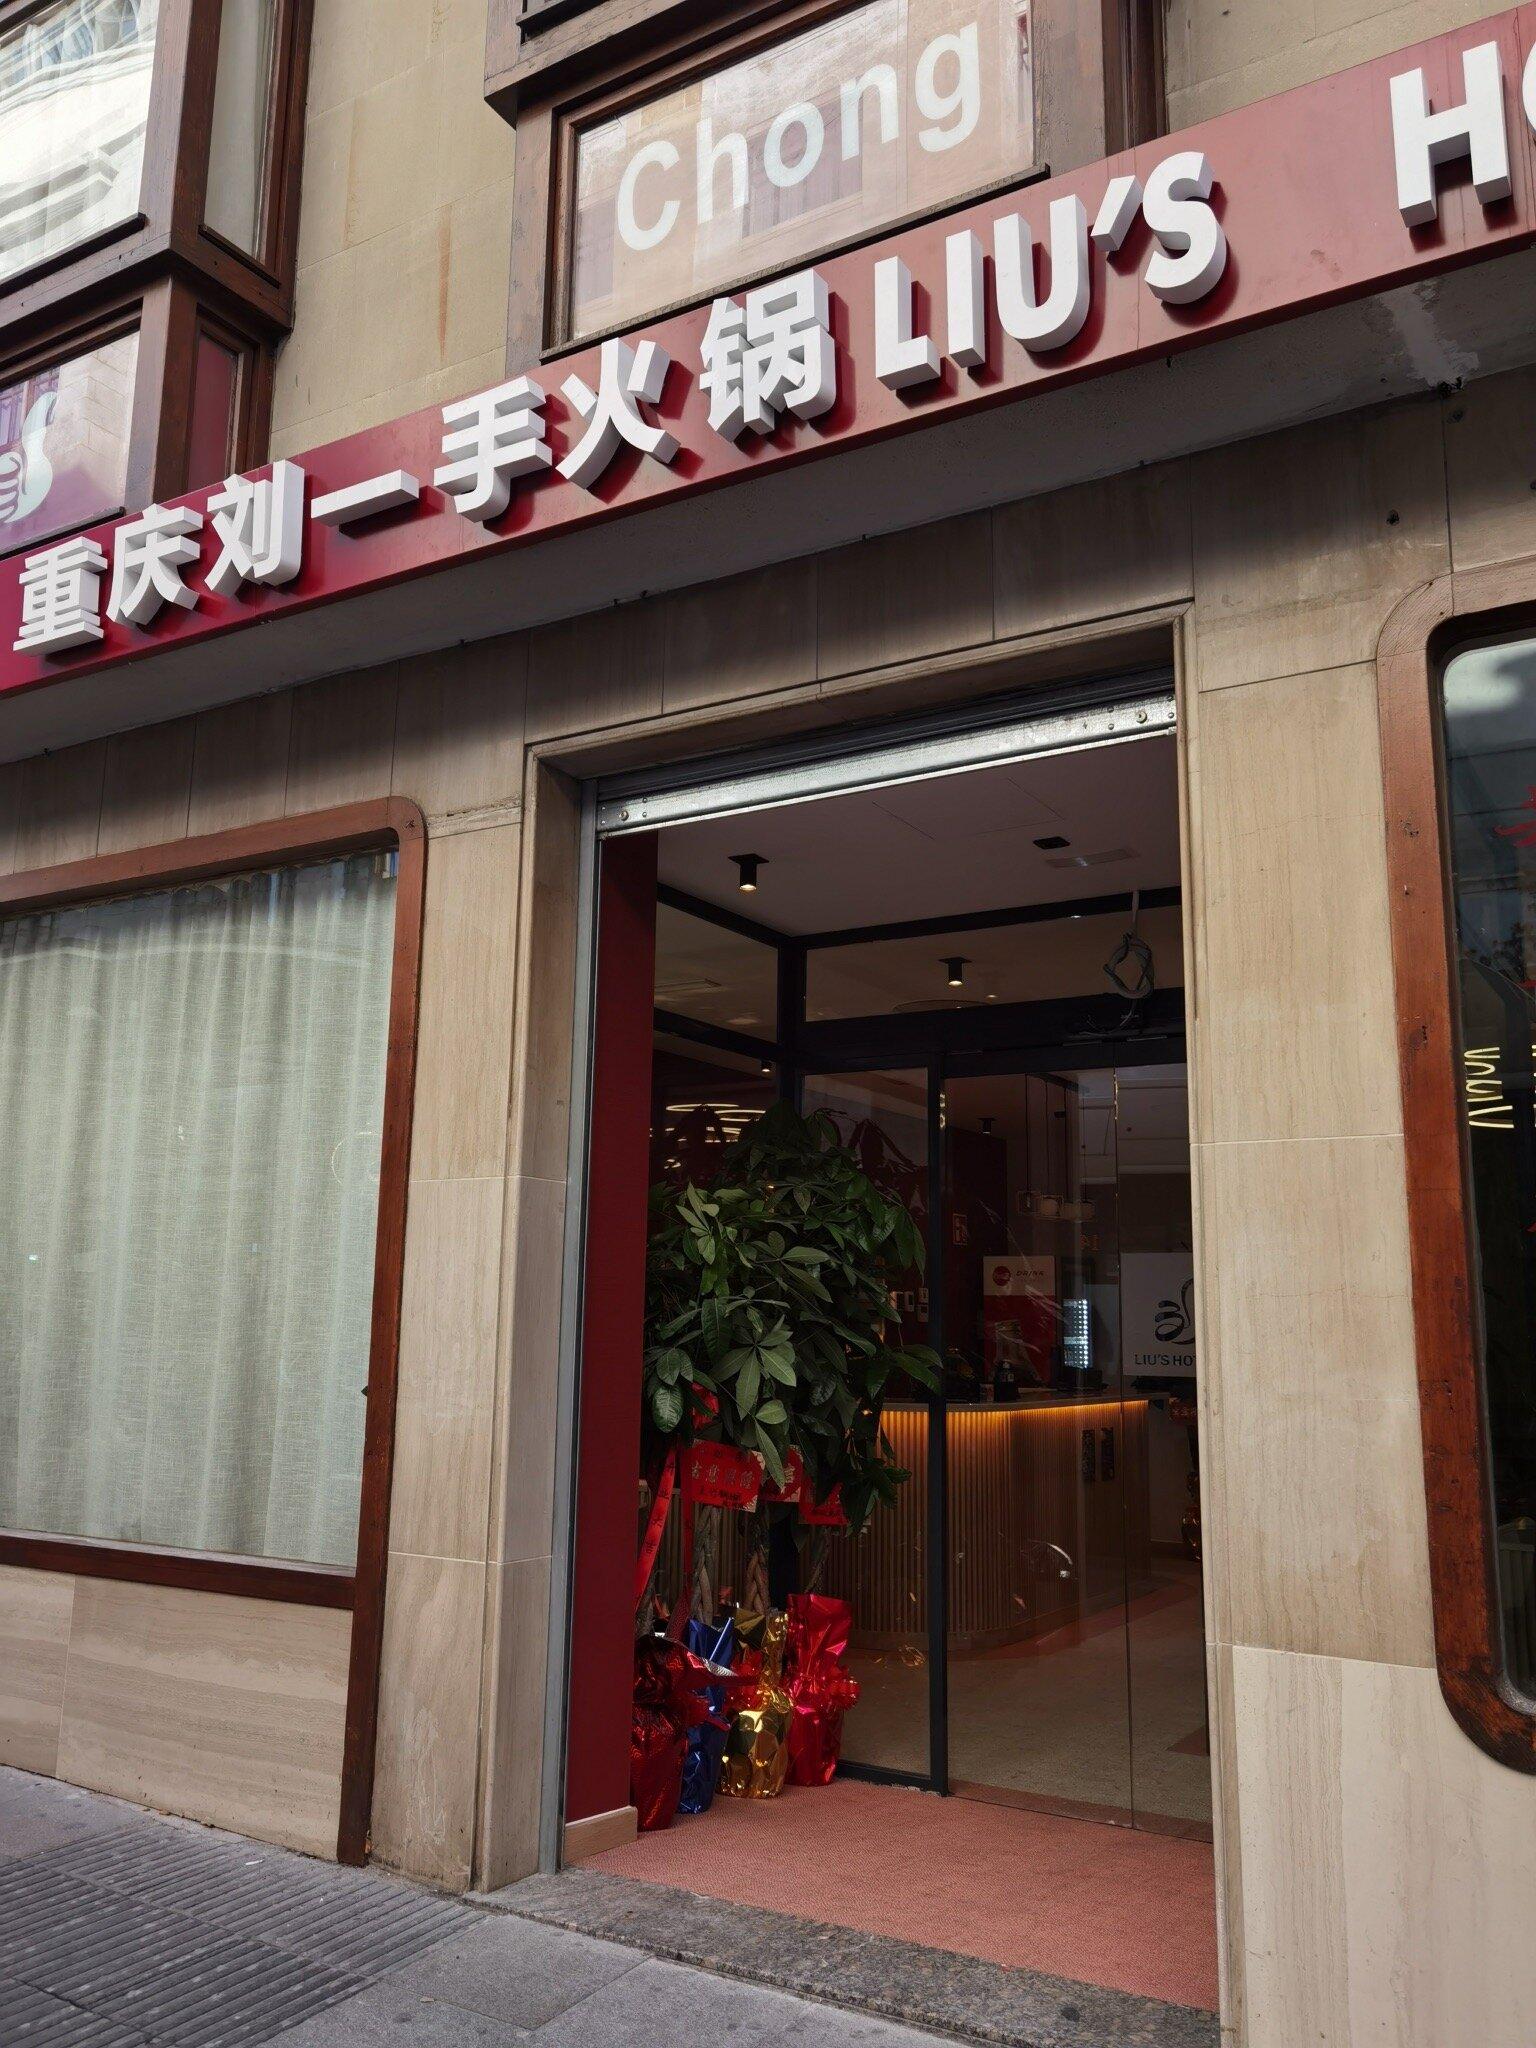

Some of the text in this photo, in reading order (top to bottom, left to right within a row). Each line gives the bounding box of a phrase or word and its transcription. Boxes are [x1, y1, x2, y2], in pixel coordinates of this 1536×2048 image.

[13, 40, 1536, 654] 重庆刘一手火锅 LIU'S H
[1134, 1354, 1170, 1366] LIU'S
